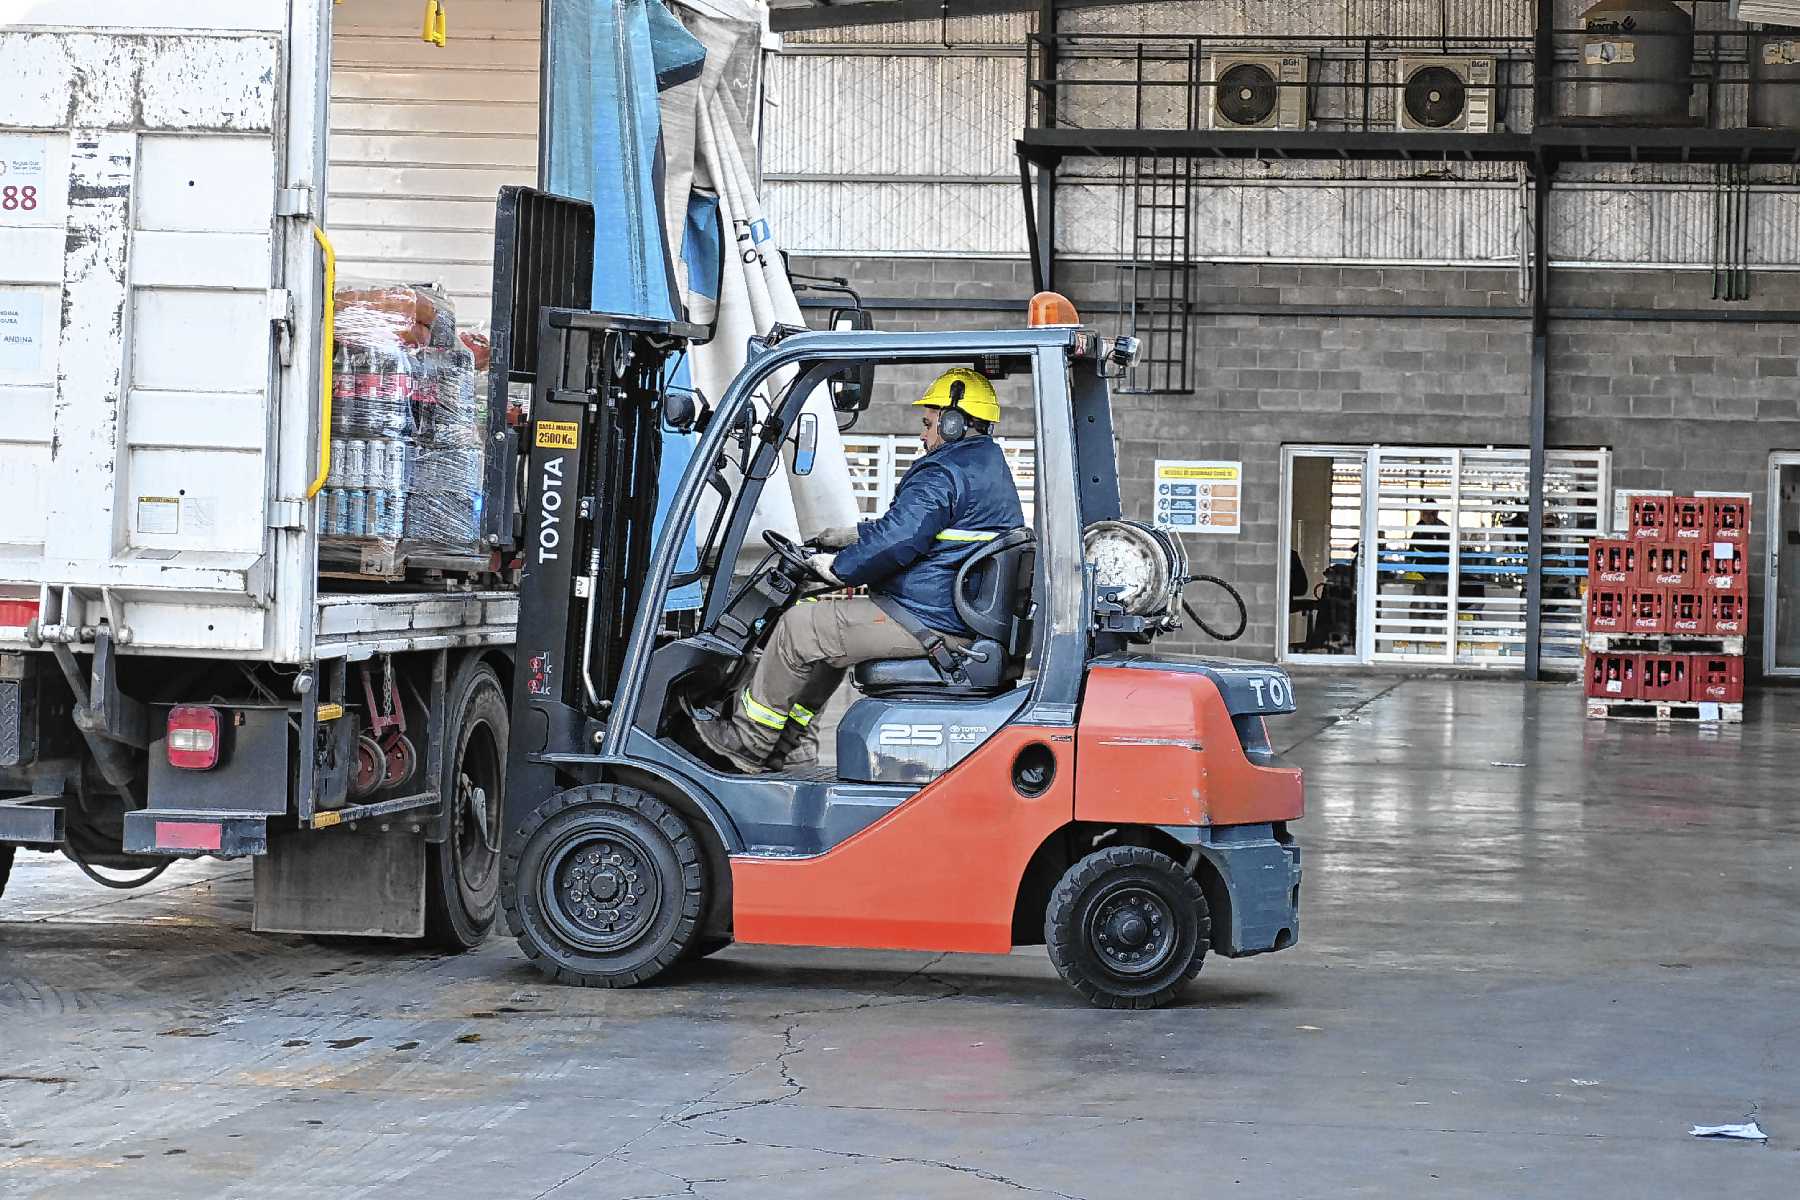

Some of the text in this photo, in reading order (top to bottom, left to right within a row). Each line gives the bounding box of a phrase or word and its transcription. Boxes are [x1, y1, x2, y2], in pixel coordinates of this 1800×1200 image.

[1283, 58, 1300, 66] BGH
[538, 432, 560, 443] 2500
[539, 457, 564, 564] TOYOTA
[880, 724, 943, 746] 25
